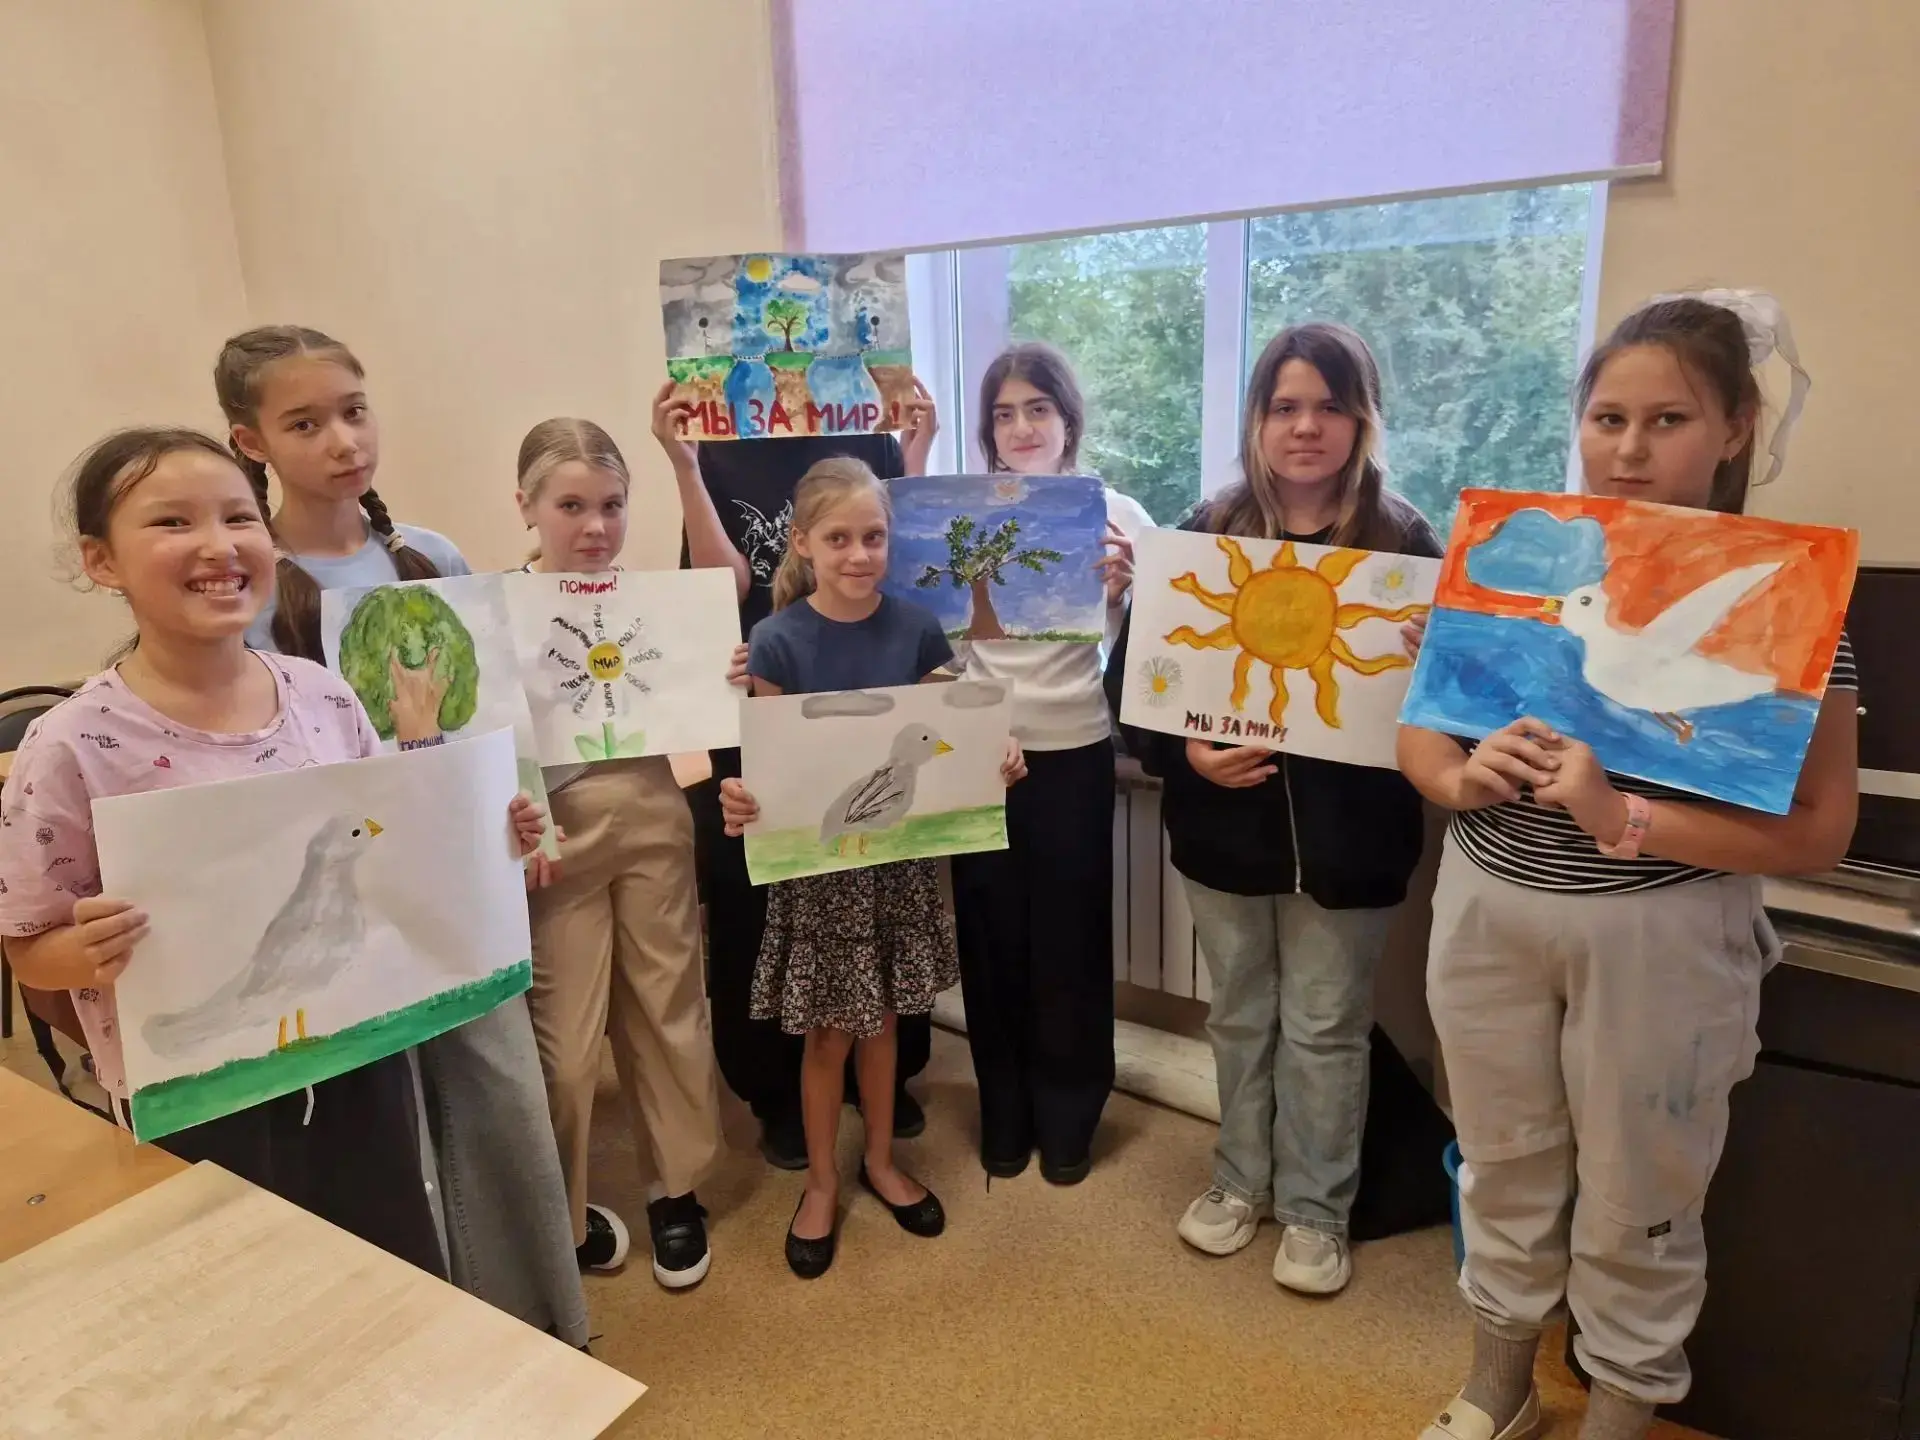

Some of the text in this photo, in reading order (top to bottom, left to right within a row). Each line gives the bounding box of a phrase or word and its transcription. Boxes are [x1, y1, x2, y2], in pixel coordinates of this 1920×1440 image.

[678, 400, 736, 435] МЫ
[748, 399, 793, 433] ЗА
[559, 575, 617, 595] ПОМНИМ!
[593, 656, 621, 671] МИР
[1184, 710, 1213, 733] МЫ
[1220, 716, 1241, 736] ЗА
